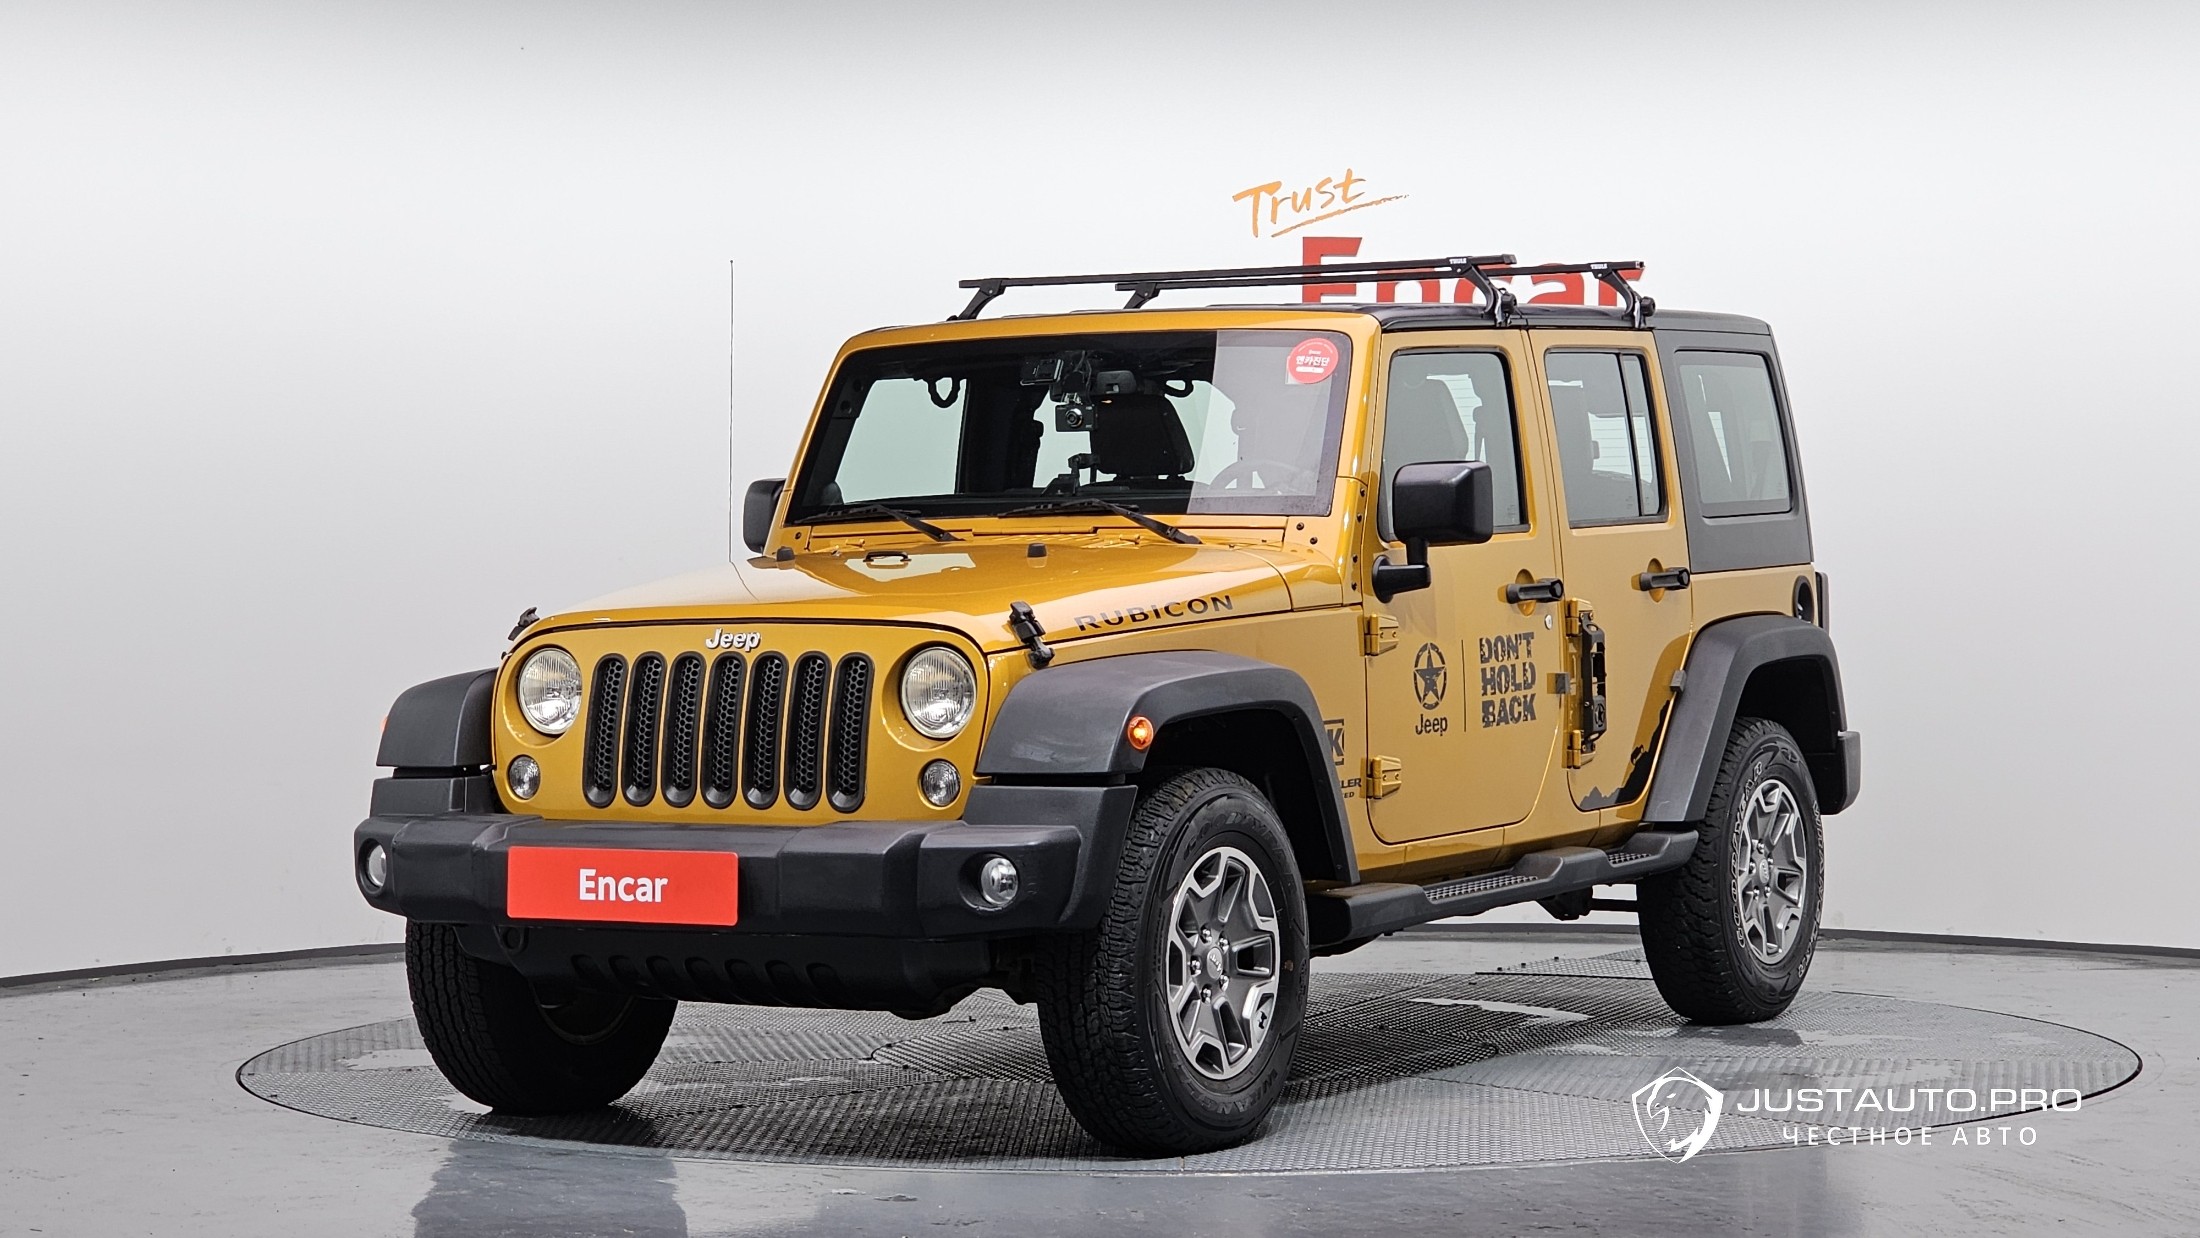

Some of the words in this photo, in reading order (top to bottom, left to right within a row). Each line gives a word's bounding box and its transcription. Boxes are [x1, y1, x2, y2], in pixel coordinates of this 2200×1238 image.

[1232, 168, 1367, 238] Trust
[1073, 595, 1234, 631] RUBICON
[705, 628, 761, 652] Jeep
[1479, 631, 1535, 664] DON'T
[1480, 661, 1537, 697] HOLD
[1415, 713, 1448, 736] Jeep
[1481, 693, 1537, 728] BACK
[579, 868, 668, 902] Encar
